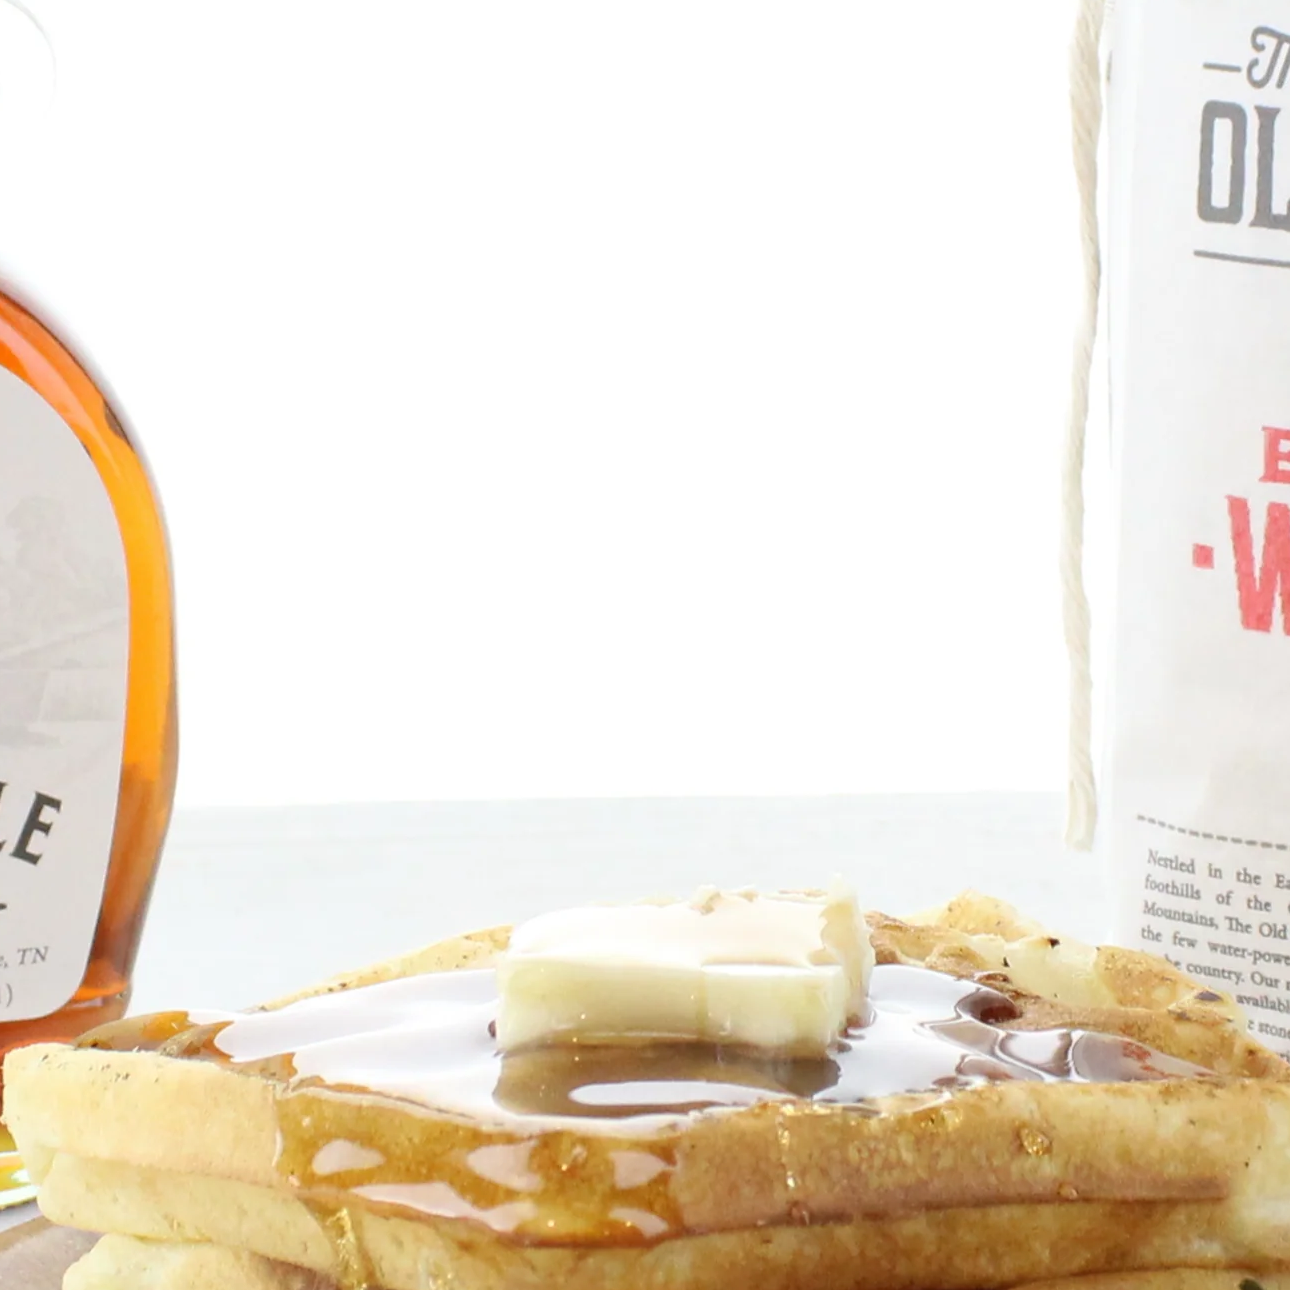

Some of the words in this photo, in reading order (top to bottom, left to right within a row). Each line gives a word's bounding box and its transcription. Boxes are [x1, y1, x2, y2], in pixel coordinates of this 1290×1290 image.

[1147, 849, 1195, 875] Nestled
[1208, 863, 1223, 879] in
[1236, 868, 1261, 885] the
[1144, 875, 1201, 900] foothills
[1216, 891, 1234, 906] of
[1247, 894, 1272, 912] the
[1143, 900, 1219, 930] Mountains,
[1225, 916, 1252, 935] The
[1259, 922, 1287, 940] Old
[1141, 926, 1162, 942] the
[1172, 931, 1198, 949] few
[17, 945, 50, 965] TN
[1186, 962, 1244, 985] country.
[1250, 971, 1280, 989] Our
